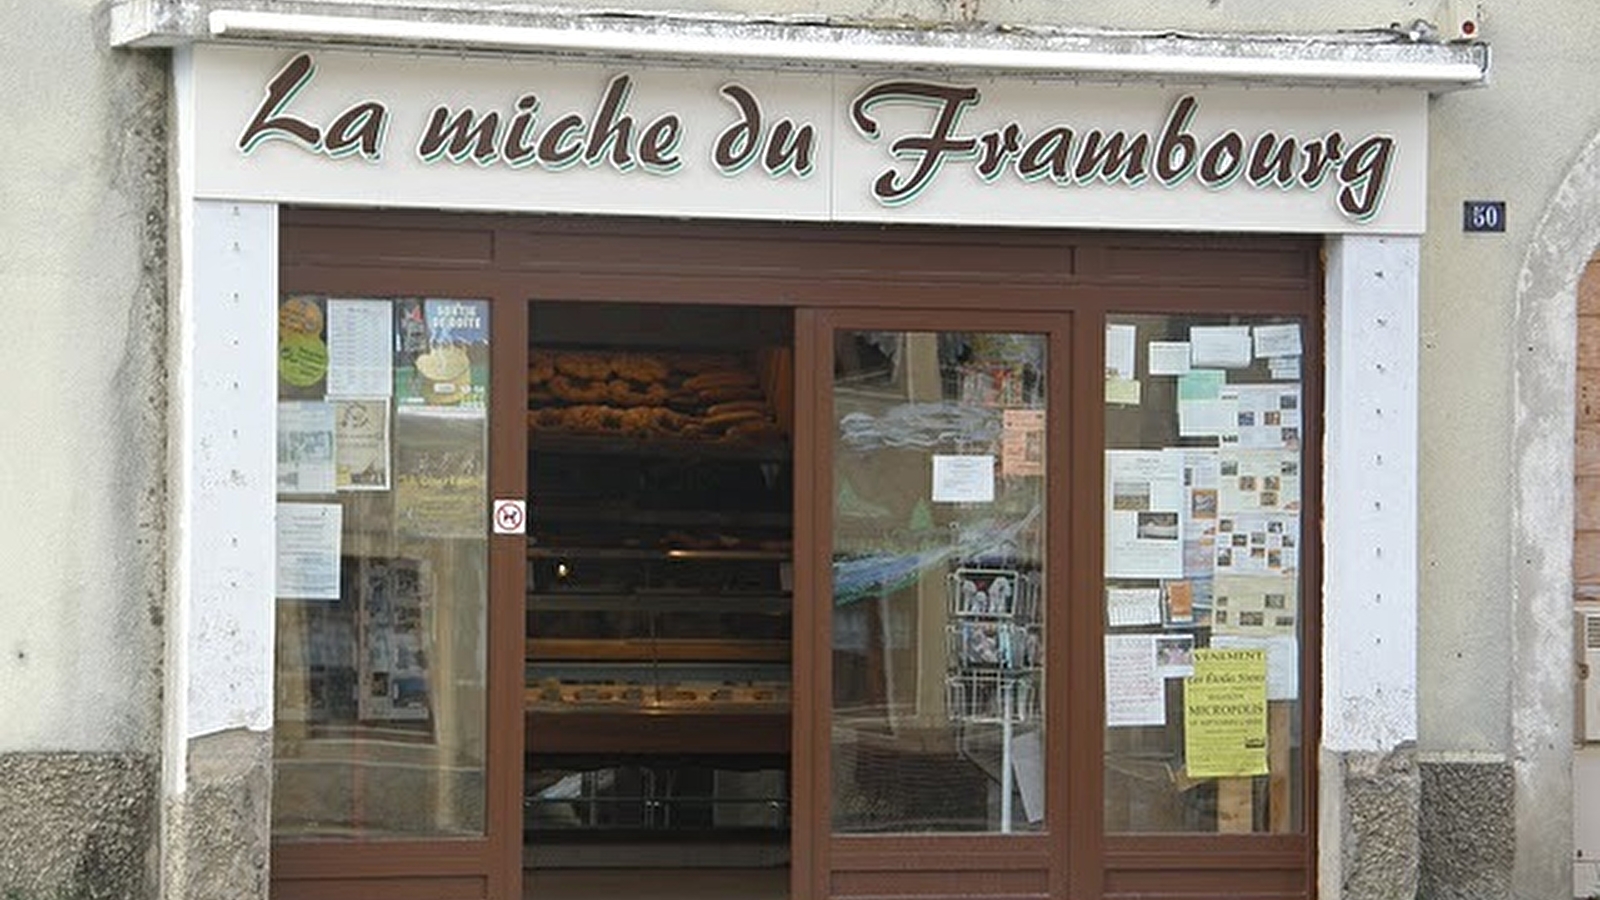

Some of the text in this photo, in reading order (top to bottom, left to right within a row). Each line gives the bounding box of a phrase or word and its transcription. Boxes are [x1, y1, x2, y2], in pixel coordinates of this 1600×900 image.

[239, 53, 1396, 221] La miche du Frambourg
[1473, 205, 1498, 228] 50
